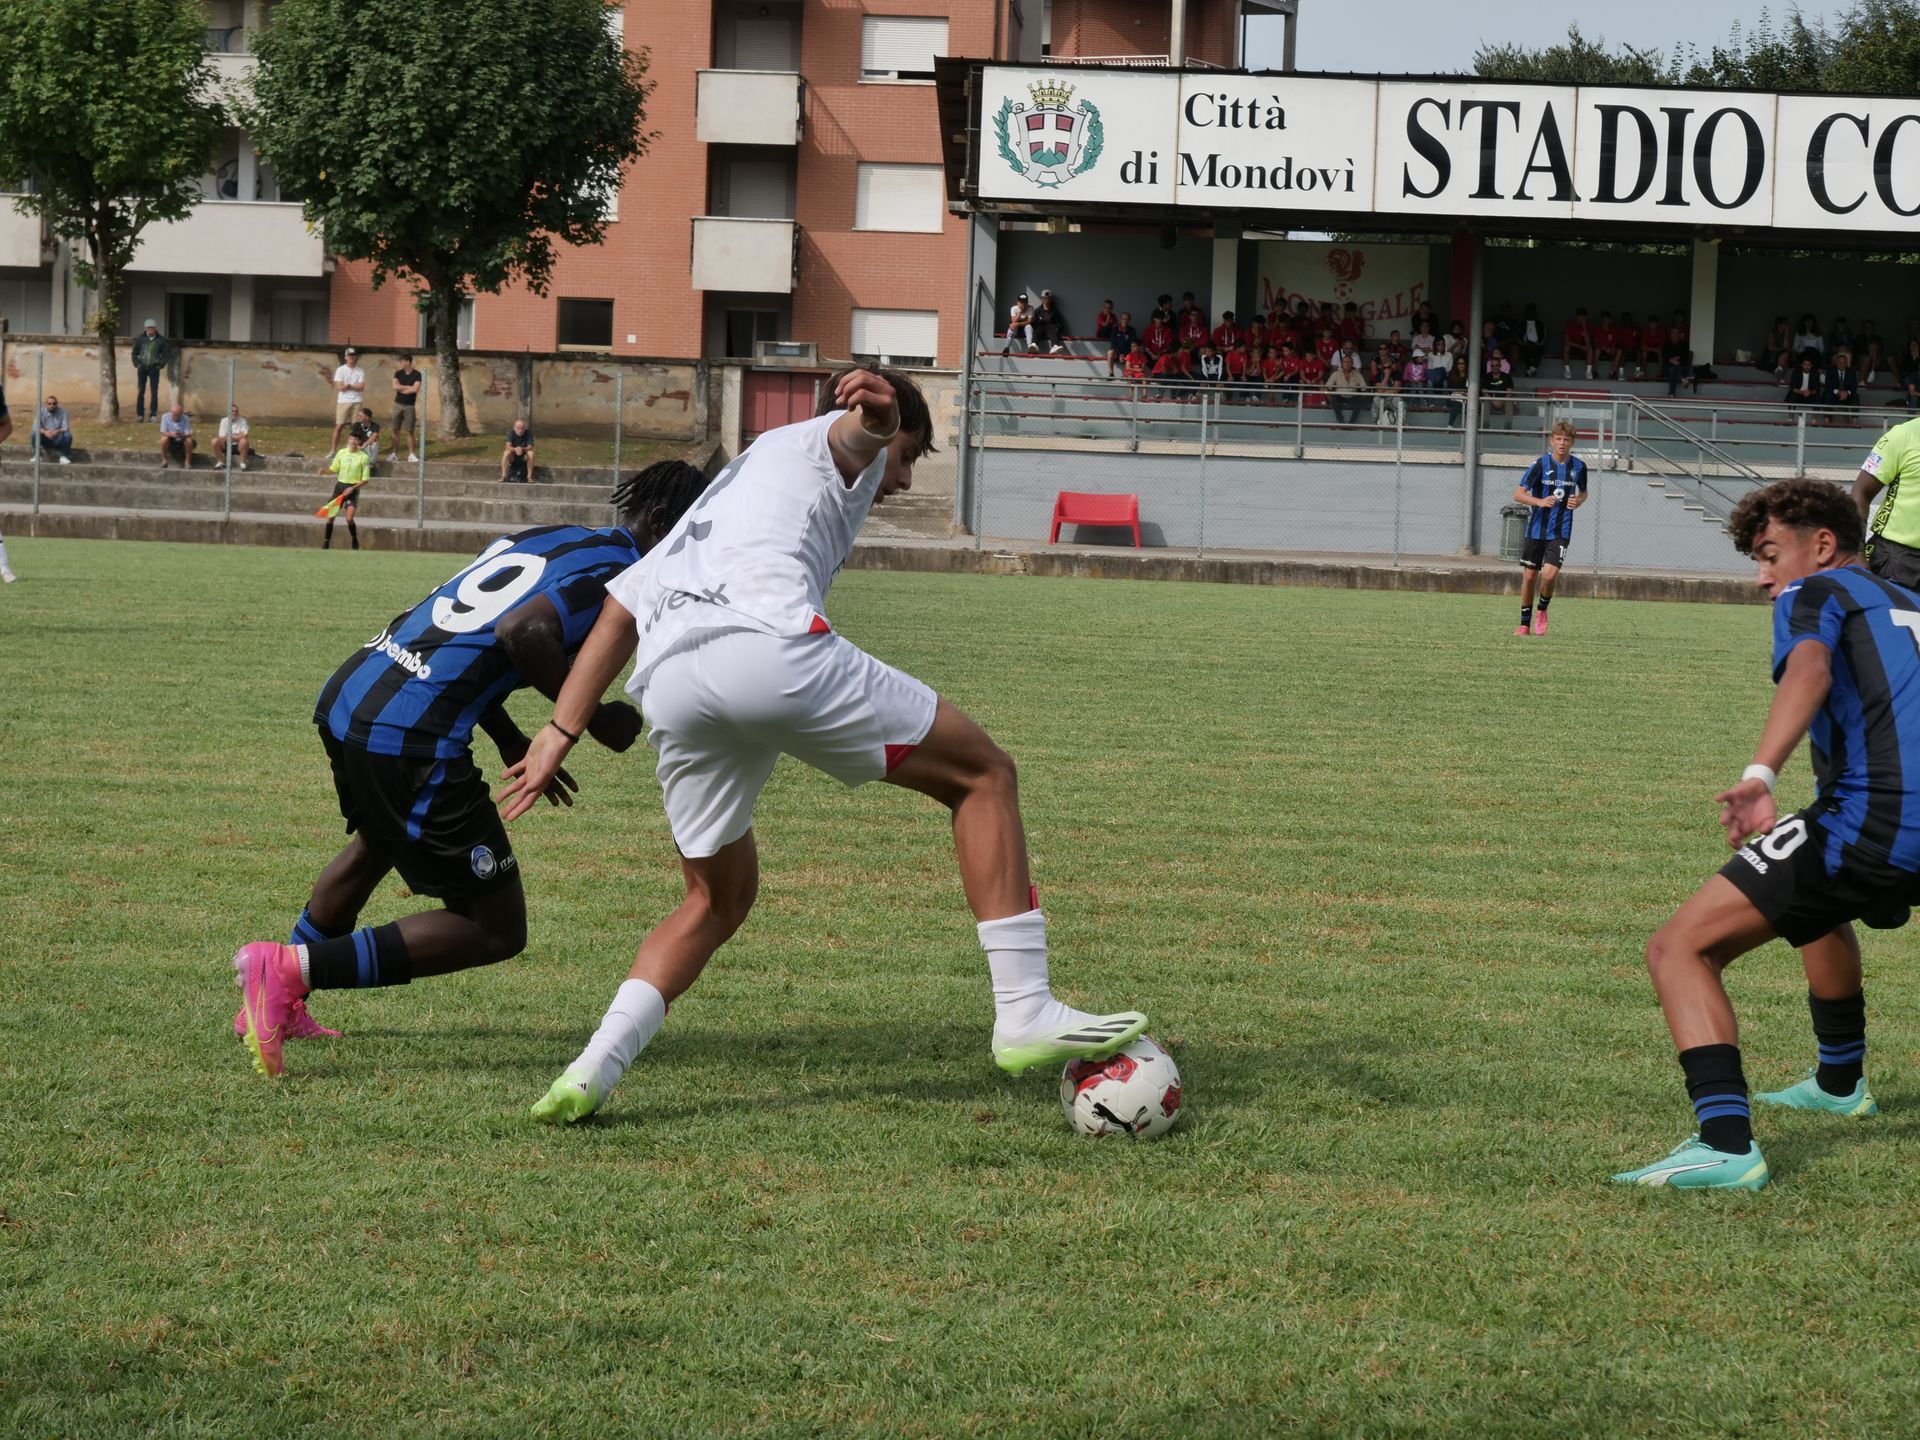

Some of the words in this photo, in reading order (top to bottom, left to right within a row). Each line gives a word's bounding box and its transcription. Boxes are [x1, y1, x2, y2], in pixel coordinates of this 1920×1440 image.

[1184, 92, 1287, 130] Città
[1119, 150, 1159, 185] di
[1177, 152, 1355, 193] Mondovì
[1402, 97, 1765, 210] STADIO
[1806, 112, 1920, 217] CO
[1262, 277, 1424, 322] MONRGALE
